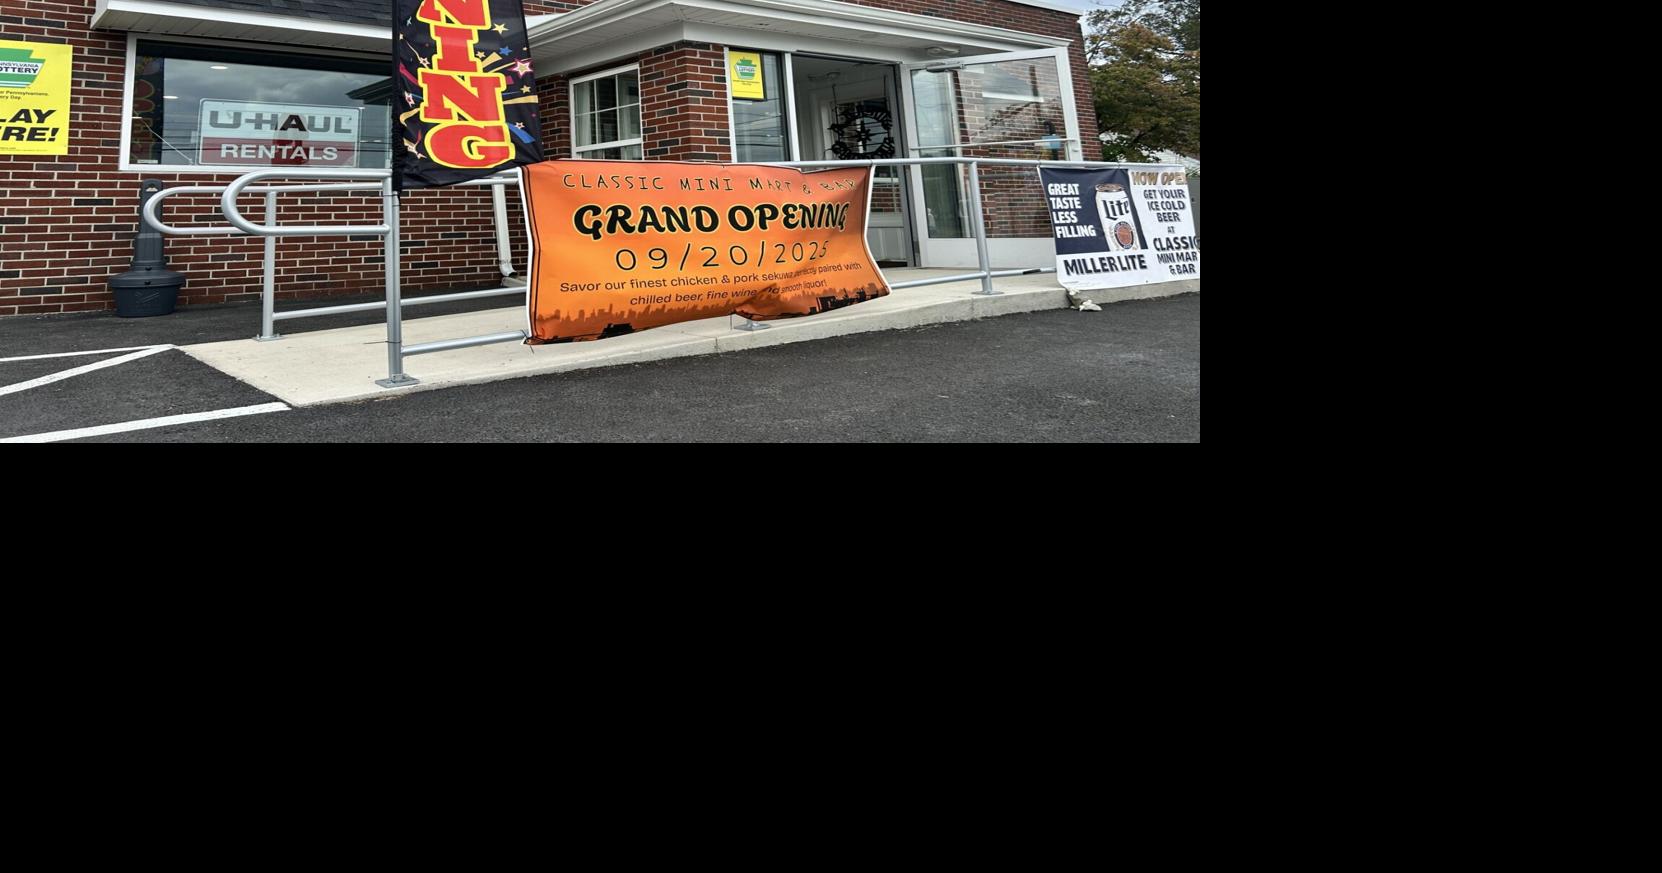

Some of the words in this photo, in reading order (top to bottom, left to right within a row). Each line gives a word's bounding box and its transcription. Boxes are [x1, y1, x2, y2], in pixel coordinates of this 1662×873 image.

[209, 110, 353, 134] U-HAUL
[0, 126, 60, 142] RE!
[220, 143, 338, 161] RENTALS
[563, 174, 665, 190] CLASSIC
[680, 177, 735, 191] MINI
[750, 177, 792, 191] MART
[1131, 171, 1159, 186] NOW
[1048, 183, 1080, 196] GREAT
[1143, 189, 1157, 199] GET
[1158, 188, 1186, 199] YOUR
[1050, 197, 1082, 210] TASTE
[1101, 196, 1130, 221] Lite
[1147, 201, 1160, 211] ICE
[1160, 200, 1186, 211] COLD
[573, 204, 720, 241] GRAND
[728, 202, 850, 232] OPENING
[1053, 211, 1078, 224] LESS
[1156, 212, 1181, 222] BEER
[1056, 225, 1097, 239] FILLING
[1167, 225, 1175, 234] AT
[615, 240, 830, 271] 09/20/2025
[1157, 252, 1175, 264] MINI
[1168, 264, 1176, 275] &
[1176, 263, 1197, 274] BAR
[560, 281, 601, 293] Savor
[605, 280, 626, 290] our
[630, 277, 667, 289] finest
[670, 275, 718, 287] chicken
[721, 274, 731, 284] &
[734, 272, 760, 285] pork
[818, 263, 843, 274] paired
[844, 261, 862, 271] with
[630, 293, 671, 306] chilled
[707, 290, 728, 301] fine
[781, 283, 803, 294] smooth
